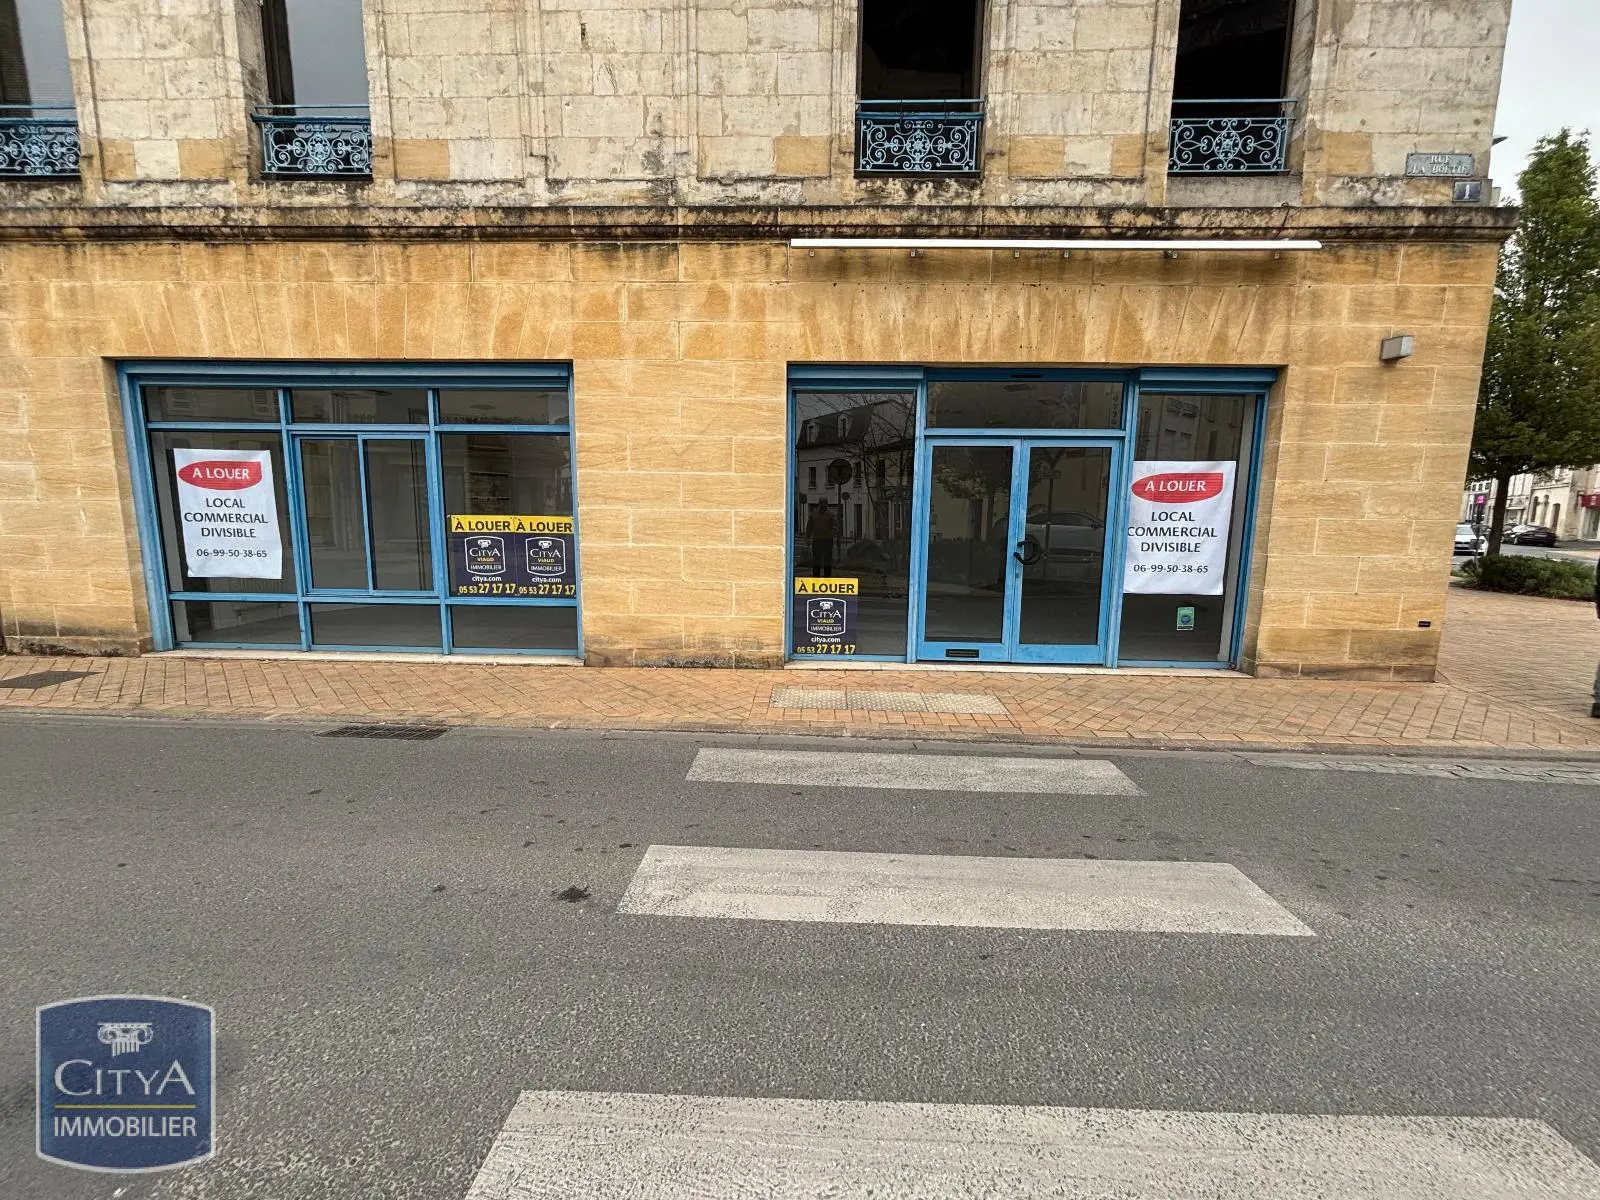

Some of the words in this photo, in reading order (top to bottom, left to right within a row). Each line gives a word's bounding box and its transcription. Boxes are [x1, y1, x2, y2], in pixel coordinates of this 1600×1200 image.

[1463, 184, 1470, 199] 1
[192, 467, 202, 478] A
[206, 468, 250, 479] LOUER
[1144, 480, 1155, 492] A
[1159, 480, 1207, 492] LOUER
[205, 498, 245, 508] LOCAL
[184, 512, 268, 524] COMMERCIAL
[1151, 511, 1195, 522] LOCAL
[455, 518, 465, 531] À
[468, 520, 511, 531] LOUER
[516, 518, 526, 532] À
[529, 521, 573, 533] LOUER
[201, 527, 256, 538] DIVISIBLE
[1127, 526, 1218, 538] COMMERCIAL
[196, 548, 267, 558] 06-99-50-38-65
[469, 547, 501, 557] CITYA
[530, 548, 561, 558] CITYA
[1140, 542, 1201, 553] DIVISIBLE
[1133, 564, 1209, 574] 06-99-50-38-65
[532, 576, 562, 584] citya.com
[459, 586, 467, 594] 05
[469, 586, 477, 594] 53
[479, 583, 489, 594] 27
[492, 583, 502, 594] 17
[505, 583, 516, 594] 17
[519, 586, 527, 594] 05
[529, 586, 537, 594] 53
[539, 584, 549, 595] 27
[552, 584, 562, 595] 17
[565, 584, 575, 596] 17
[798, 580, 808, 593] À
[811, 583, 855, 593] LOUER
[810, 609, 841, 618] CITYA
[816, 644, 828, 654] 27
[830, 644, 841, 654] 17
[844, 644, 856, 654] 17
